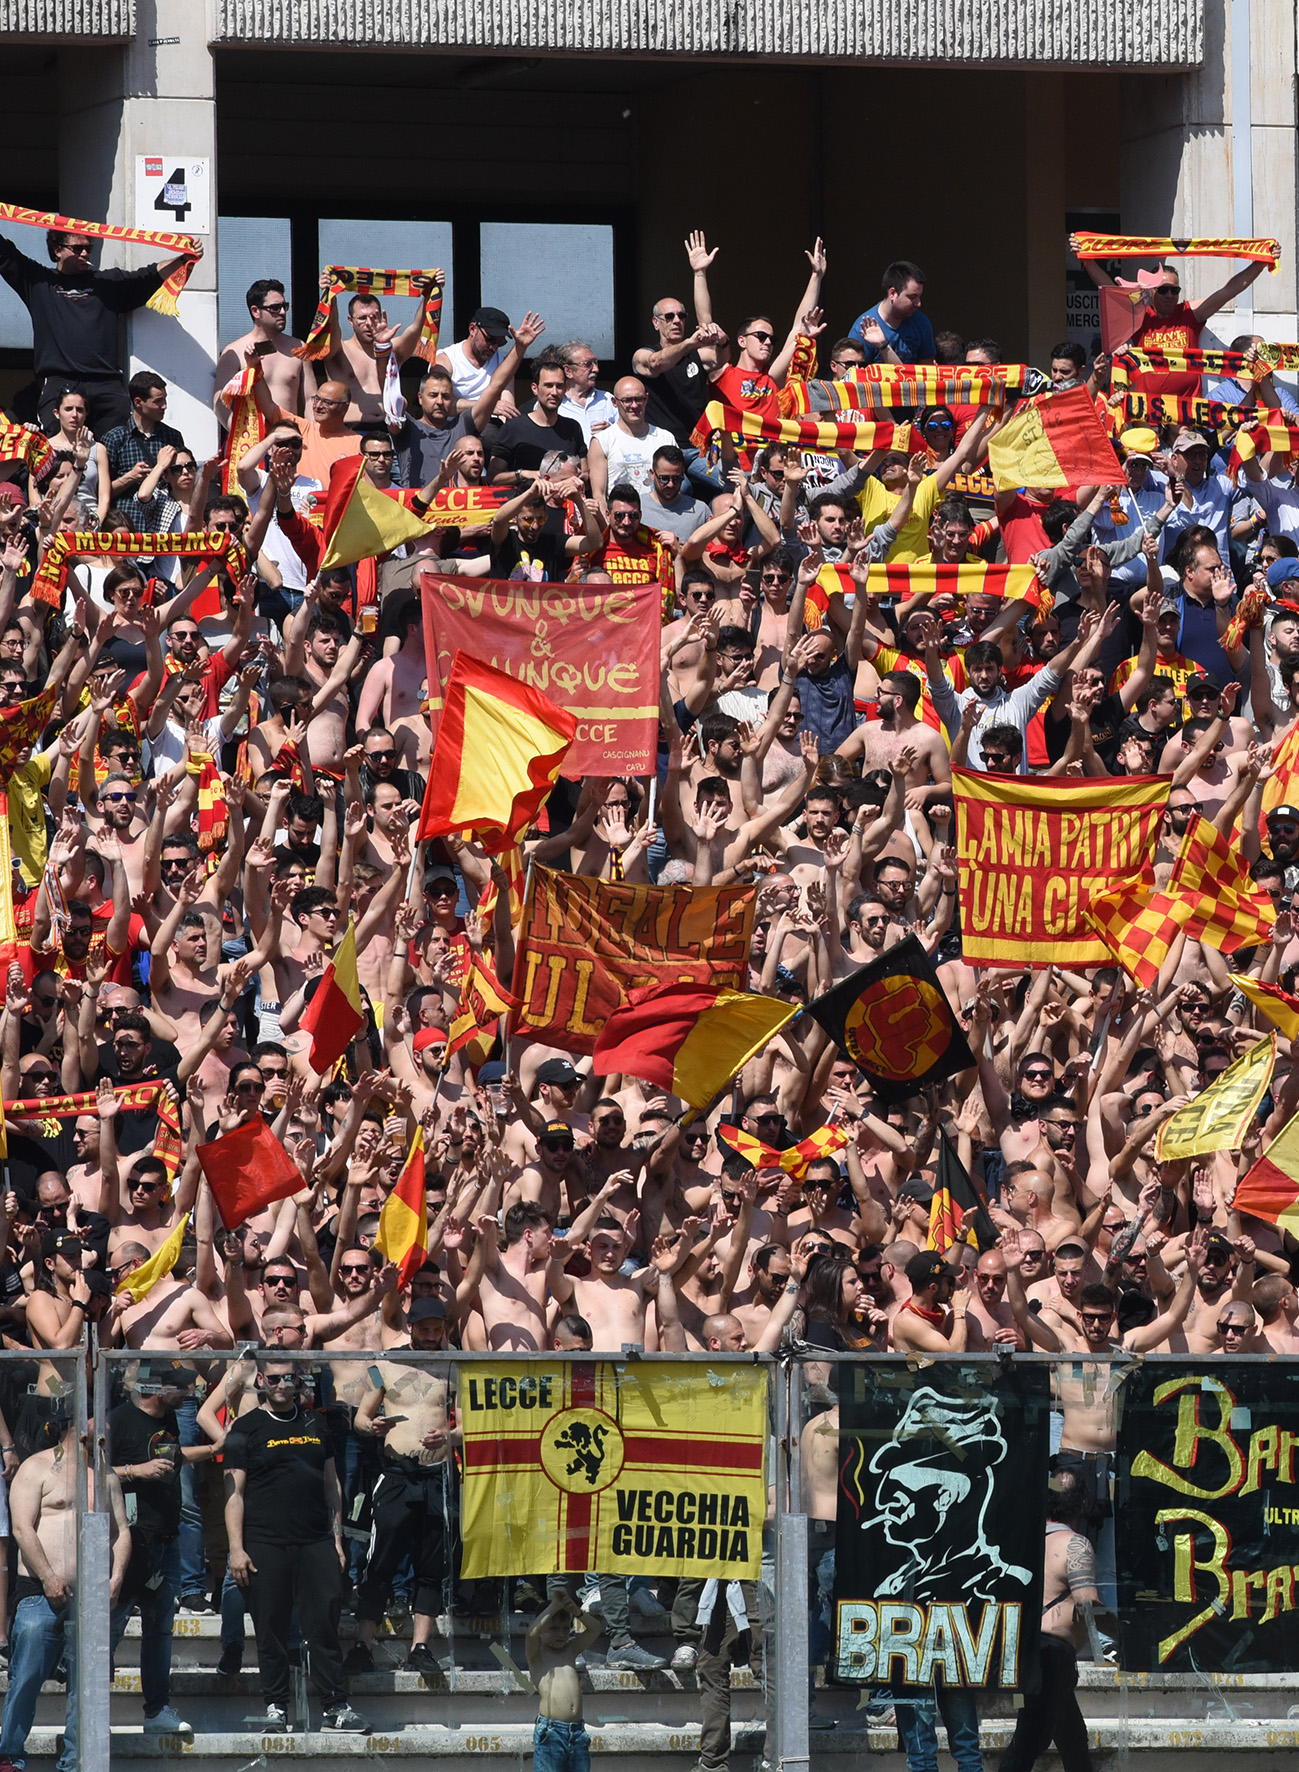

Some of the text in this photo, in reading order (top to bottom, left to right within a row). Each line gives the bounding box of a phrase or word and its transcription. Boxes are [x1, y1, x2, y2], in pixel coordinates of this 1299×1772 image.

[154, 168, 192, 222] 4
[0, 202, 57, 226] NZA
[1079, 238, 1274, 252] CUORE SALENTIN
[1065, 313, 1100, 328] MERG
[1066, 294, 1100, 310] USCIT
[945, 473, 996, 498] LECC
[75, 531, 225, 552] MOLLEREMO
[438, 580, 639, 626] OVUNQUE
[529, 618, 555, 658] &
[1059, 808, 1158, 869] PATRIA
[1043, 875, 1130, 935] CIT
[468, 1375, 553, 1412] LECCE
[616, 1489, 750, 1528] VECCHIA
[612, 1523, 750, 1563] GUARDIA
[836, 1598, 1023, 1689] BRAVI
[261, 1736, 296, 1752] 063
[465, 1736, 501, 1752] 065
